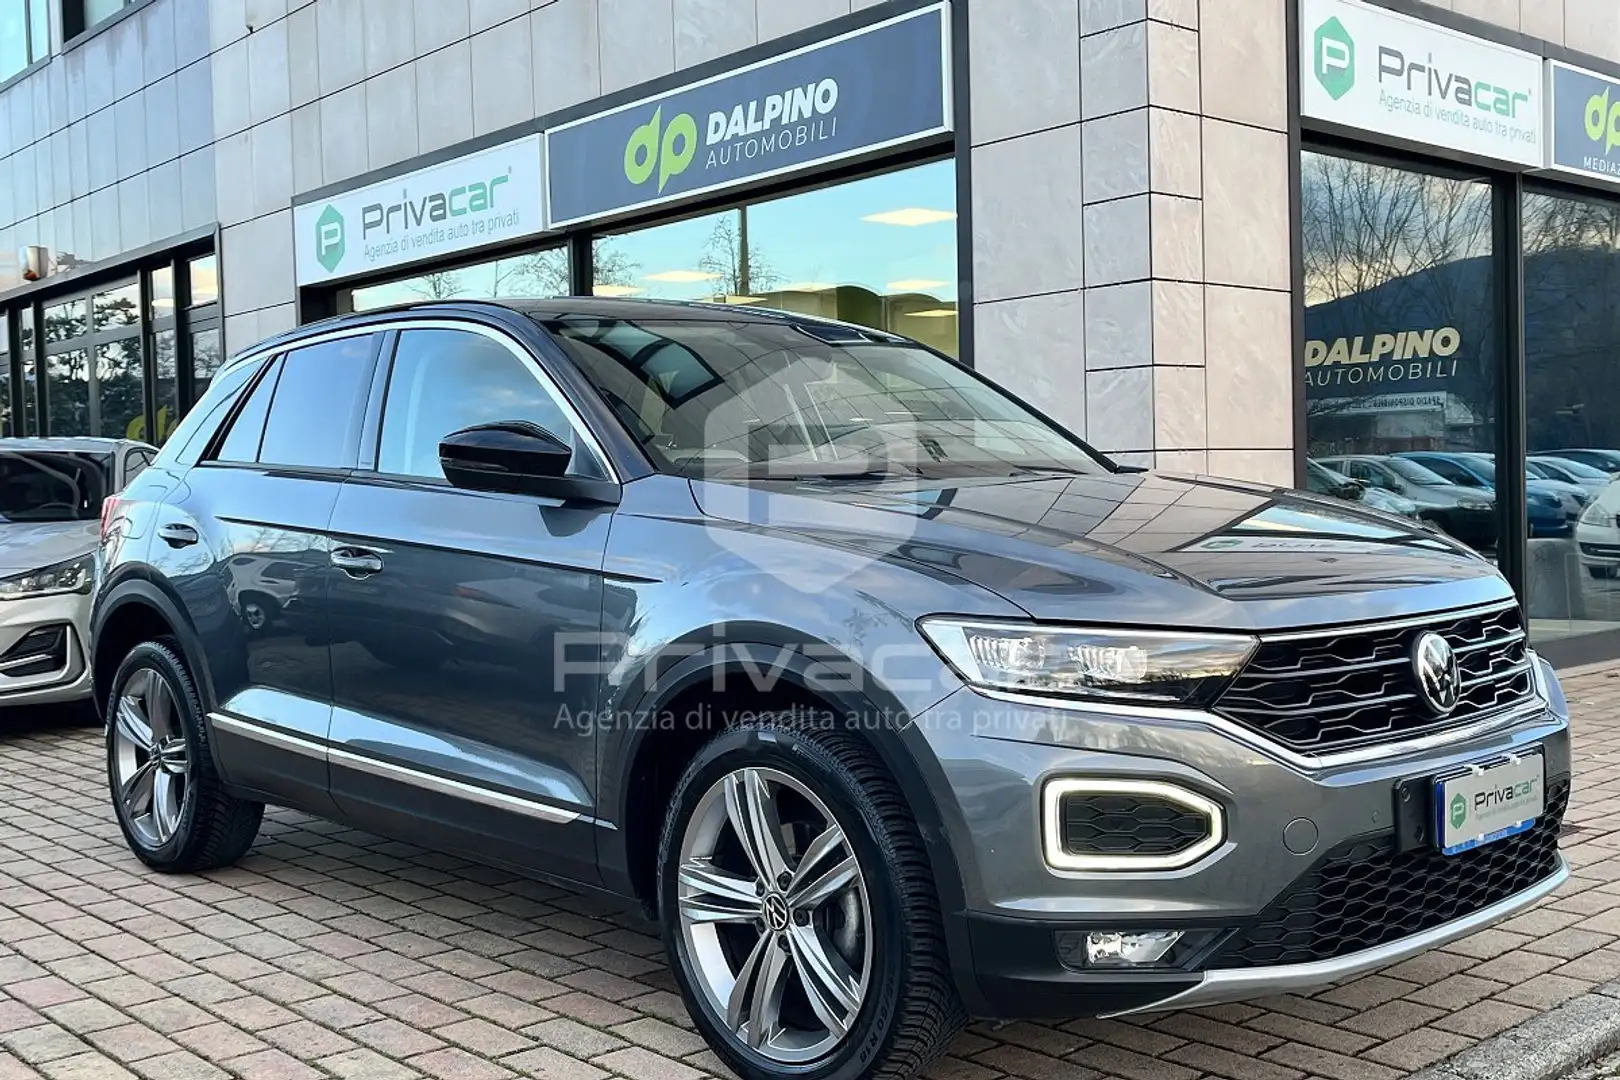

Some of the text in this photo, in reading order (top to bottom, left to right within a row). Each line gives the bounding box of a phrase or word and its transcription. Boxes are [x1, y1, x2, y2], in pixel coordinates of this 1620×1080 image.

[1378, 46, 1528, 119] Privacar
[706, 77, 838, 146] DALPINO
[1379, 89, 1536, 144] Agenzia di vendita auto tra privati
[705, 117, 837, 169] AUTOMOBILI
[362, 172, 508, 240] Privacar
[364, 207, 520, 262] Agenzia di vendita auto tra privati
[1304, 326, 1461, 368] DALPINO
[1305, 360, 1457, 387] AUTOMOBILI
[1474, 778, 1537, 811] Privacar
